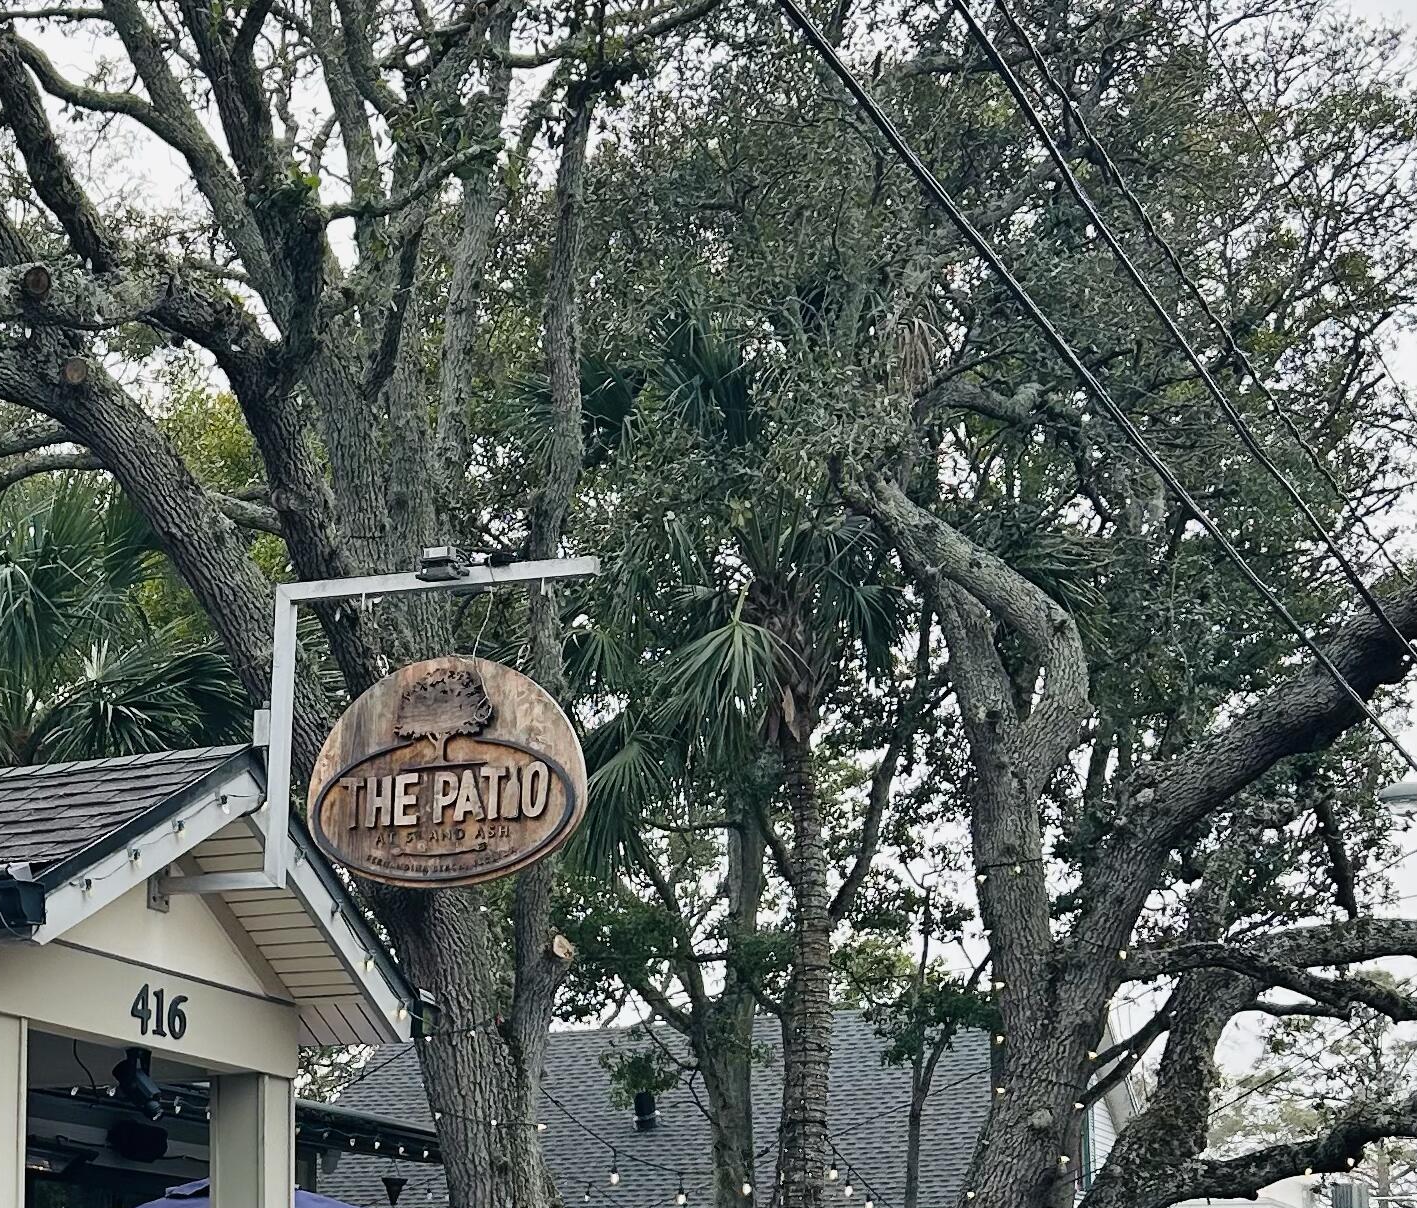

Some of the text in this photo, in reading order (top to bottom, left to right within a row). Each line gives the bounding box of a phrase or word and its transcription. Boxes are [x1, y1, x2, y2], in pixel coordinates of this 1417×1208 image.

[339, 760, 549, 829] THE PATIO
[428, 829, 466, 842] AND
[474, 824, 510, 841] ASH
[130, 983, 189, 1040] 416
